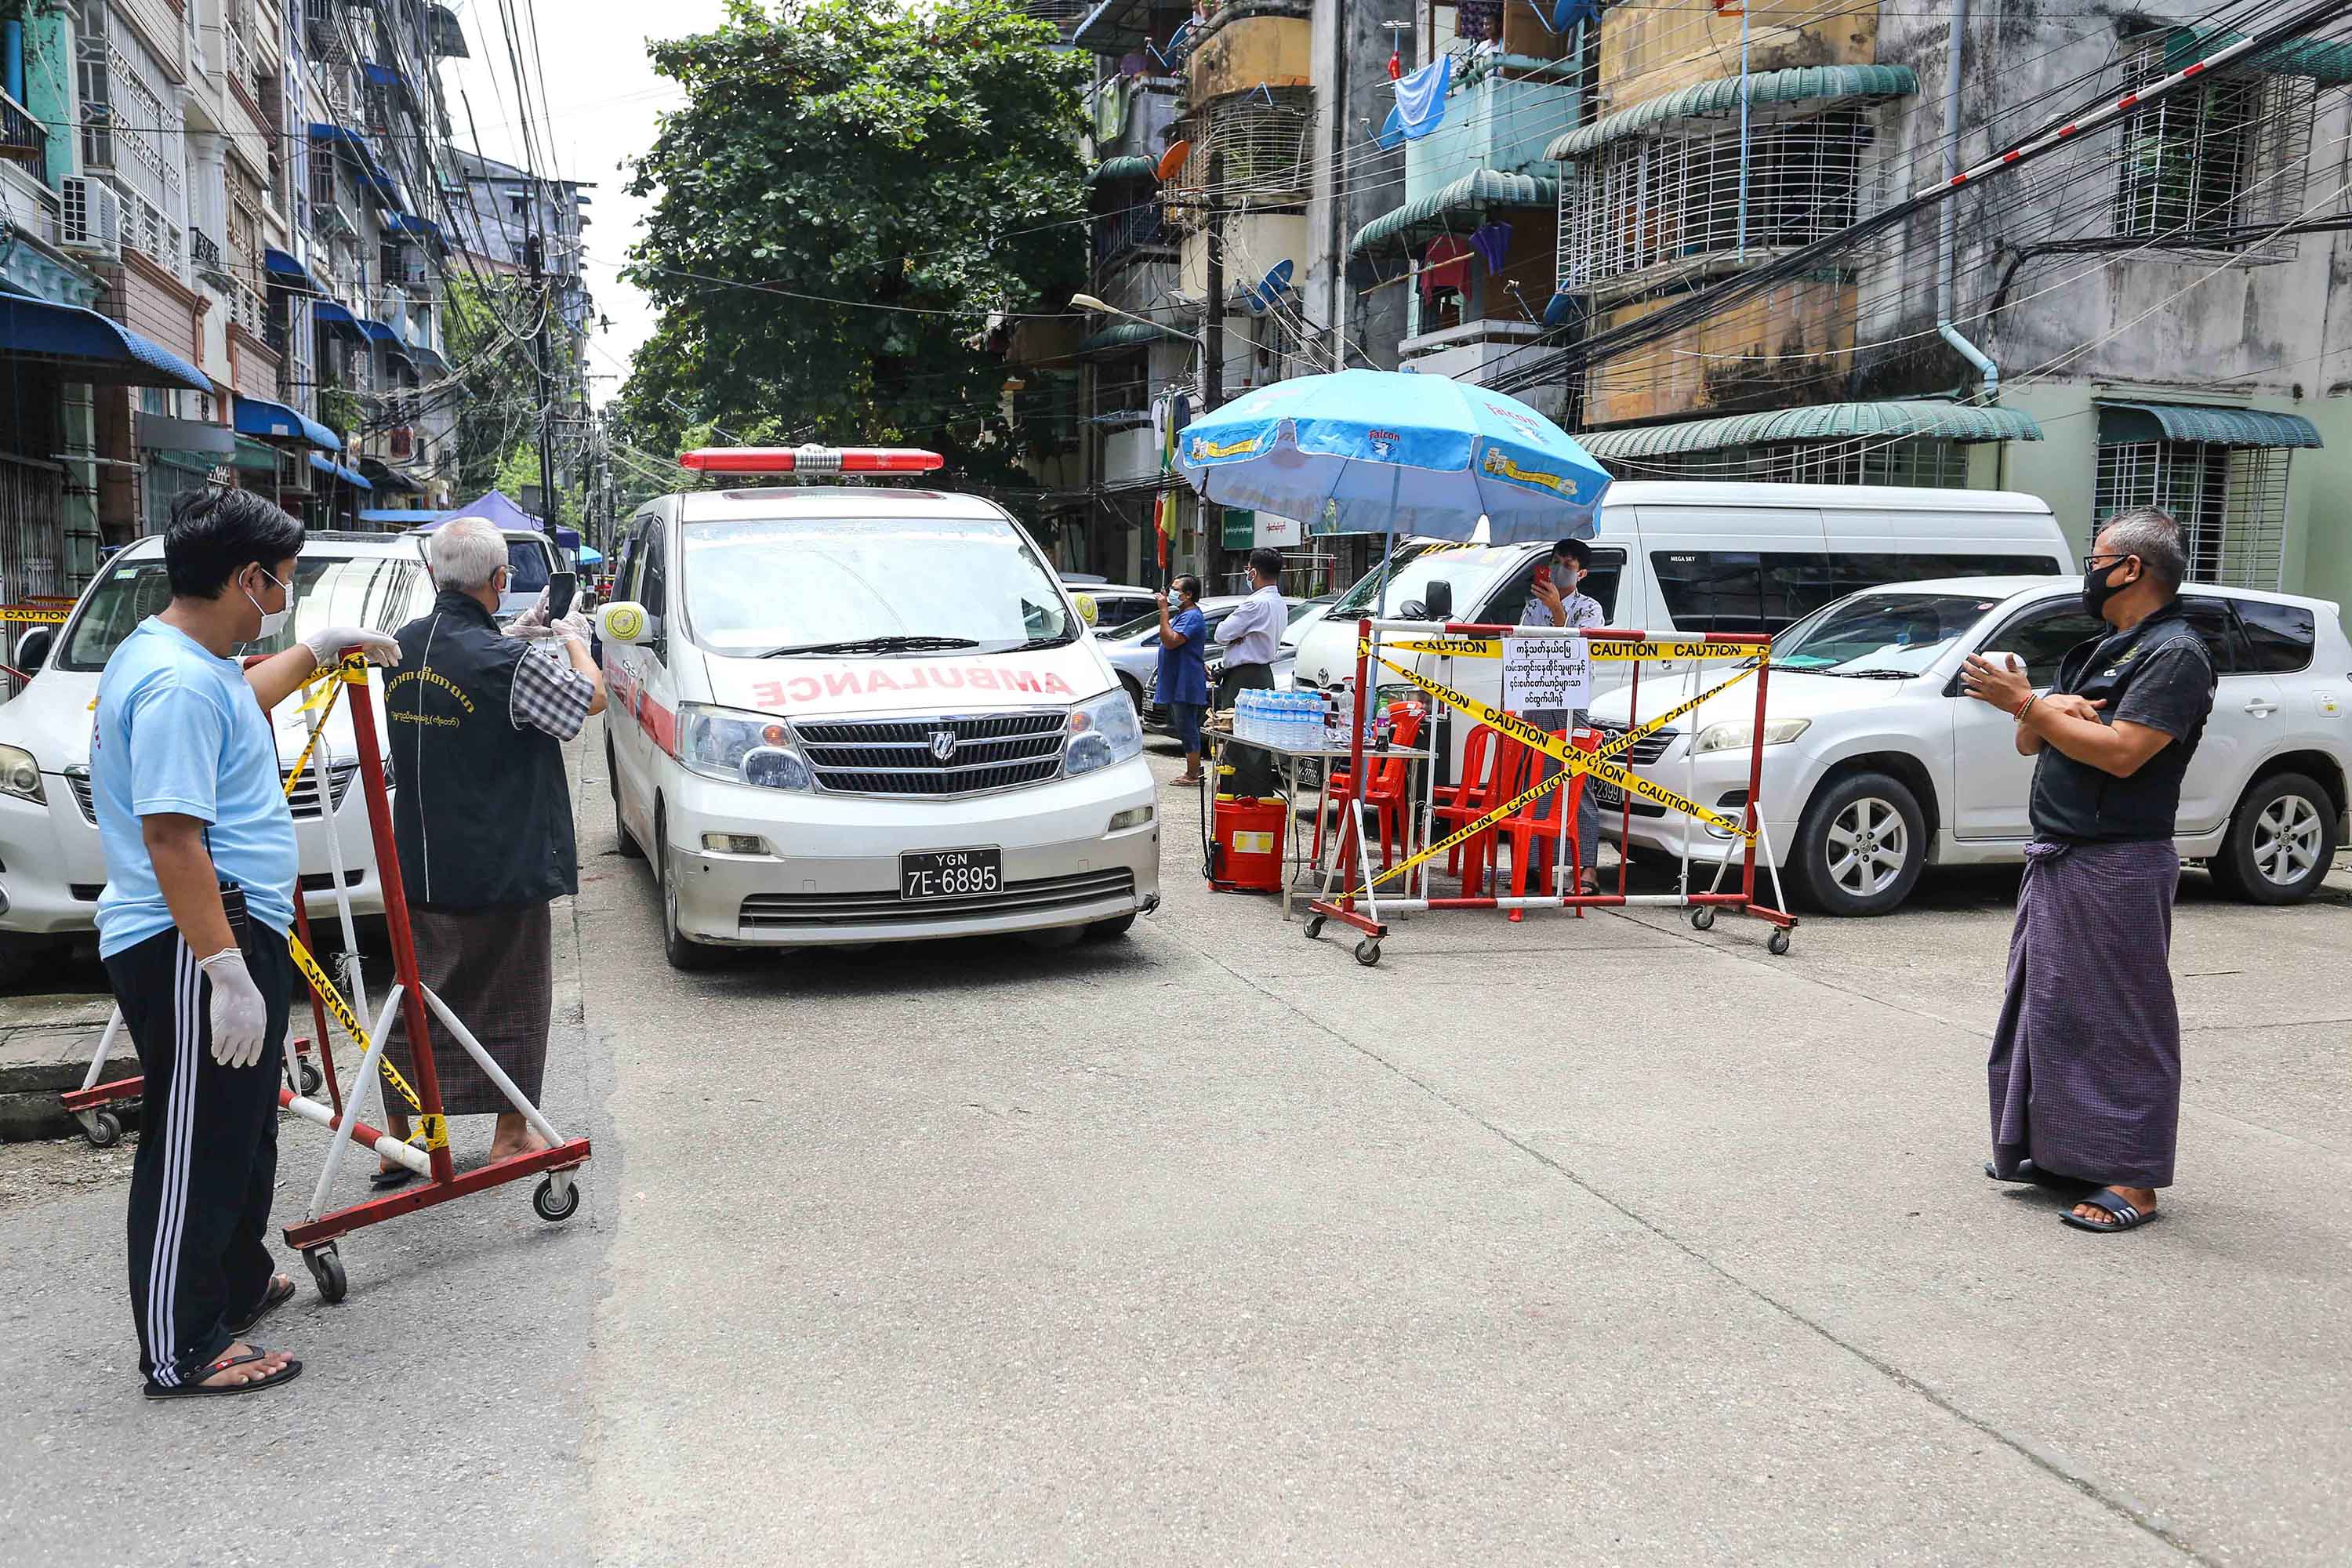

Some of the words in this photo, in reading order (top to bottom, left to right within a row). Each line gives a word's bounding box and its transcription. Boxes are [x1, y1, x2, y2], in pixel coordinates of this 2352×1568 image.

[1369, 430, 1399, 441] Falcon
[5, 611, 70, 619] CAUTION
[1413, 641, 1487, 654] CAUTION
[1590, 644, 1658, 656] CAUTION
[1674, 644, 1741, 656] CAUTION
[1402, 669, 1470, 709] CAUTION
[1484, 708, 1550, 747] CAUTION
[1637, 781, 1700, 816] CAUTION
[1507, 769, 1573, 811] CAUTION
[1587, 724, 1650, 767] CAUTION
[1664, 684, 1726, 723] CAUTION
[1592, 779, 1619, 800] -2399
[935, 853, 967, 866] YGN
[908, 866, 996, 895] 7E-6895
